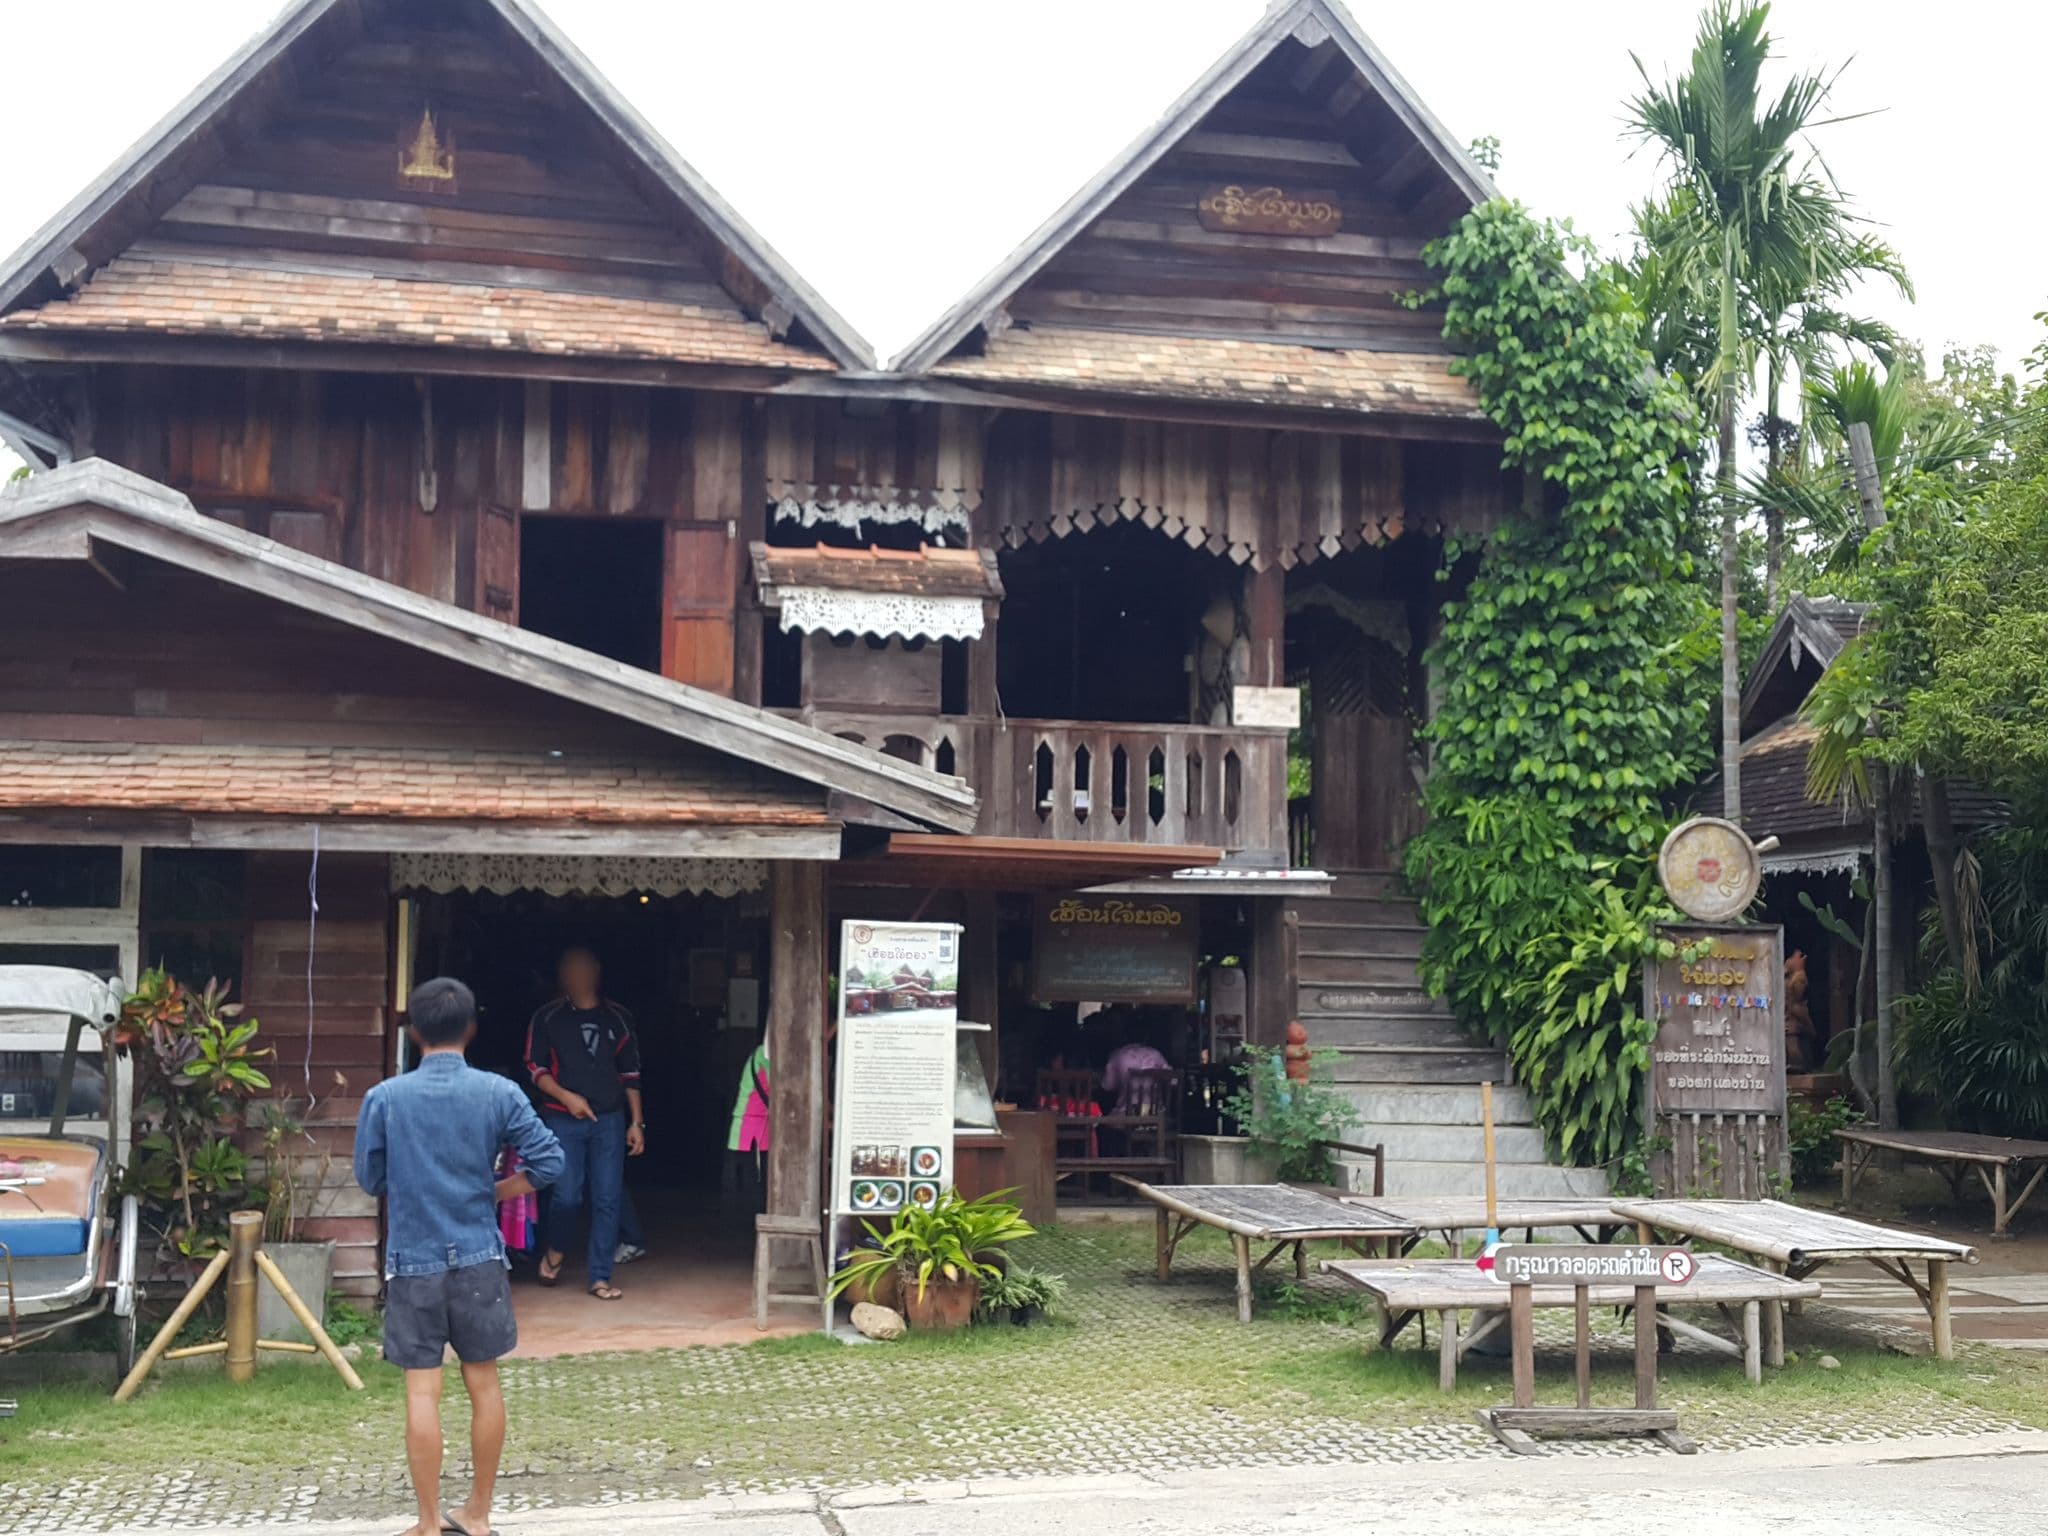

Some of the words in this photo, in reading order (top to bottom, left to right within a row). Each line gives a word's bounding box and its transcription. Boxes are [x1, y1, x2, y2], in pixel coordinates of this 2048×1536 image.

[1506, 1248, 1661, 1281] กรุณาจอดรถด้านใน
